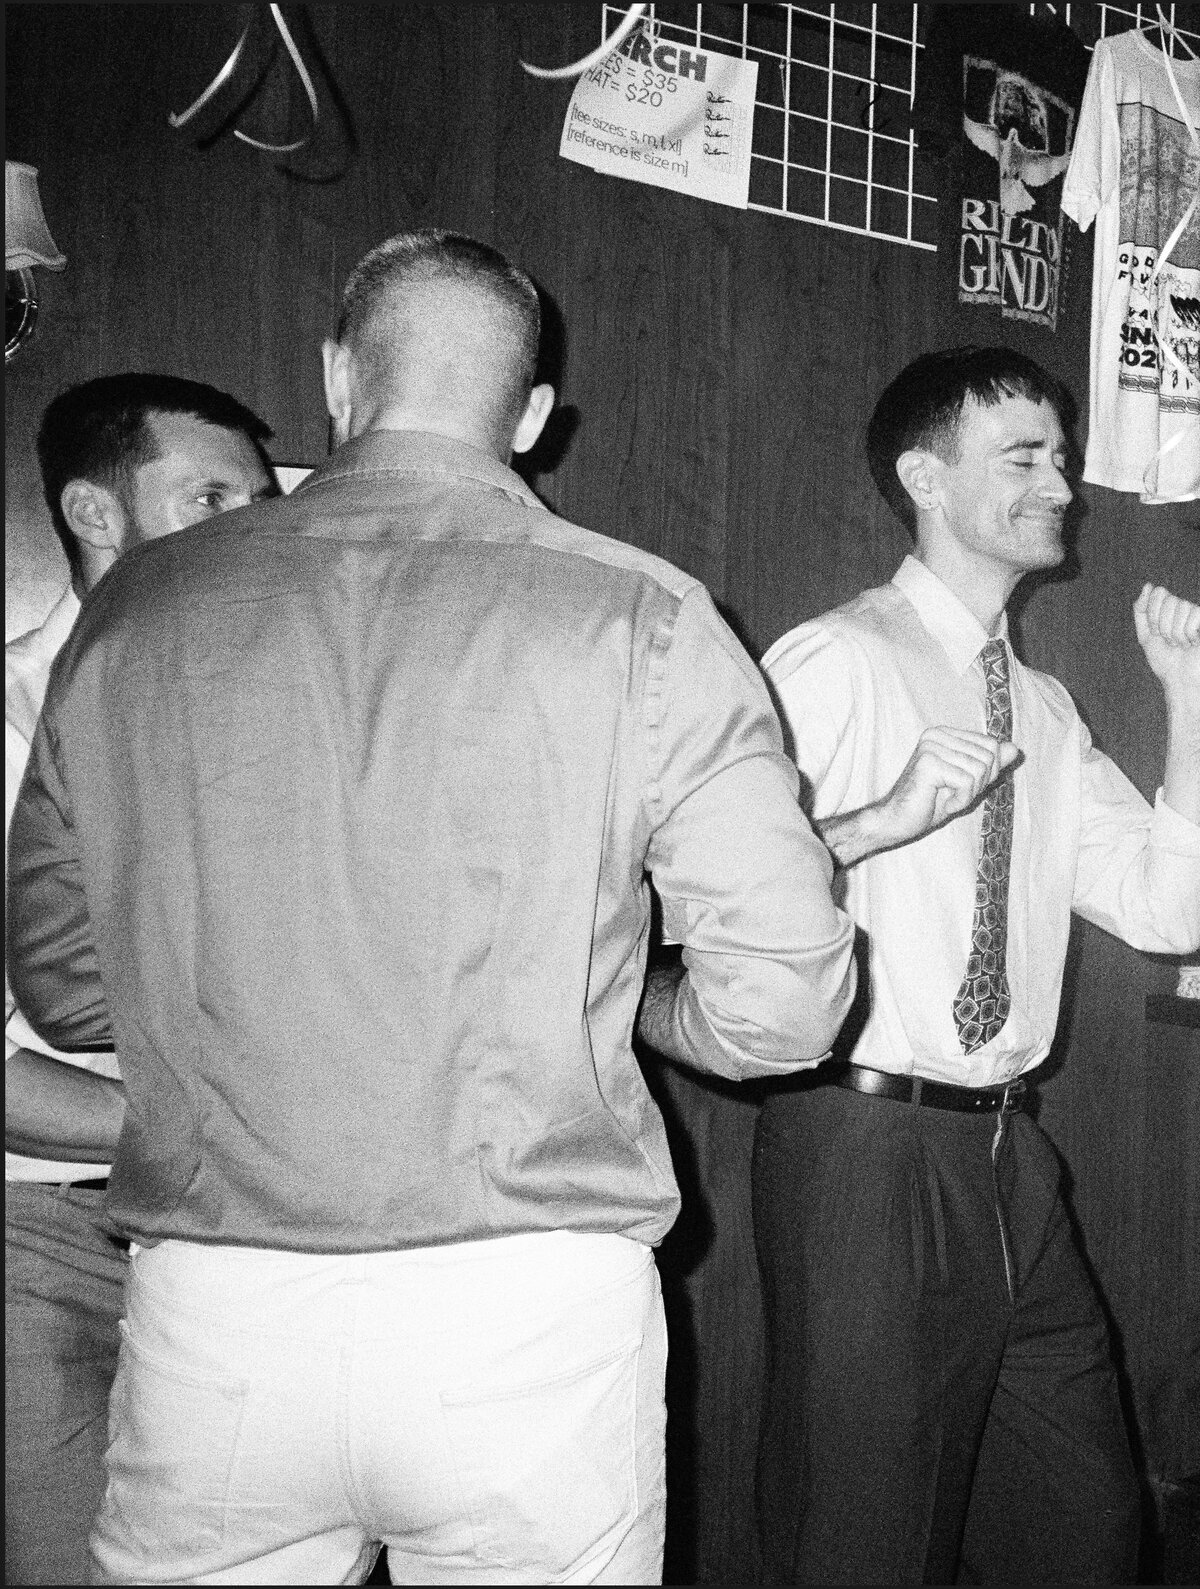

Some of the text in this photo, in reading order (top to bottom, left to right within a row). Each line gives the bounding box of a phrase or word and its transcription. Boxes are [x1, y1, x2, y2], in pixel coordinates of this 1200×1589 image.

[615, 32, 707, 82] ERCH
[643, 69, 678, 93] $35
[626, 83, 662, 107] $20
[592, 117, 628, 138] sizes:
[630, 147, 641, 161] is
[644, 153, 669, 169] size
